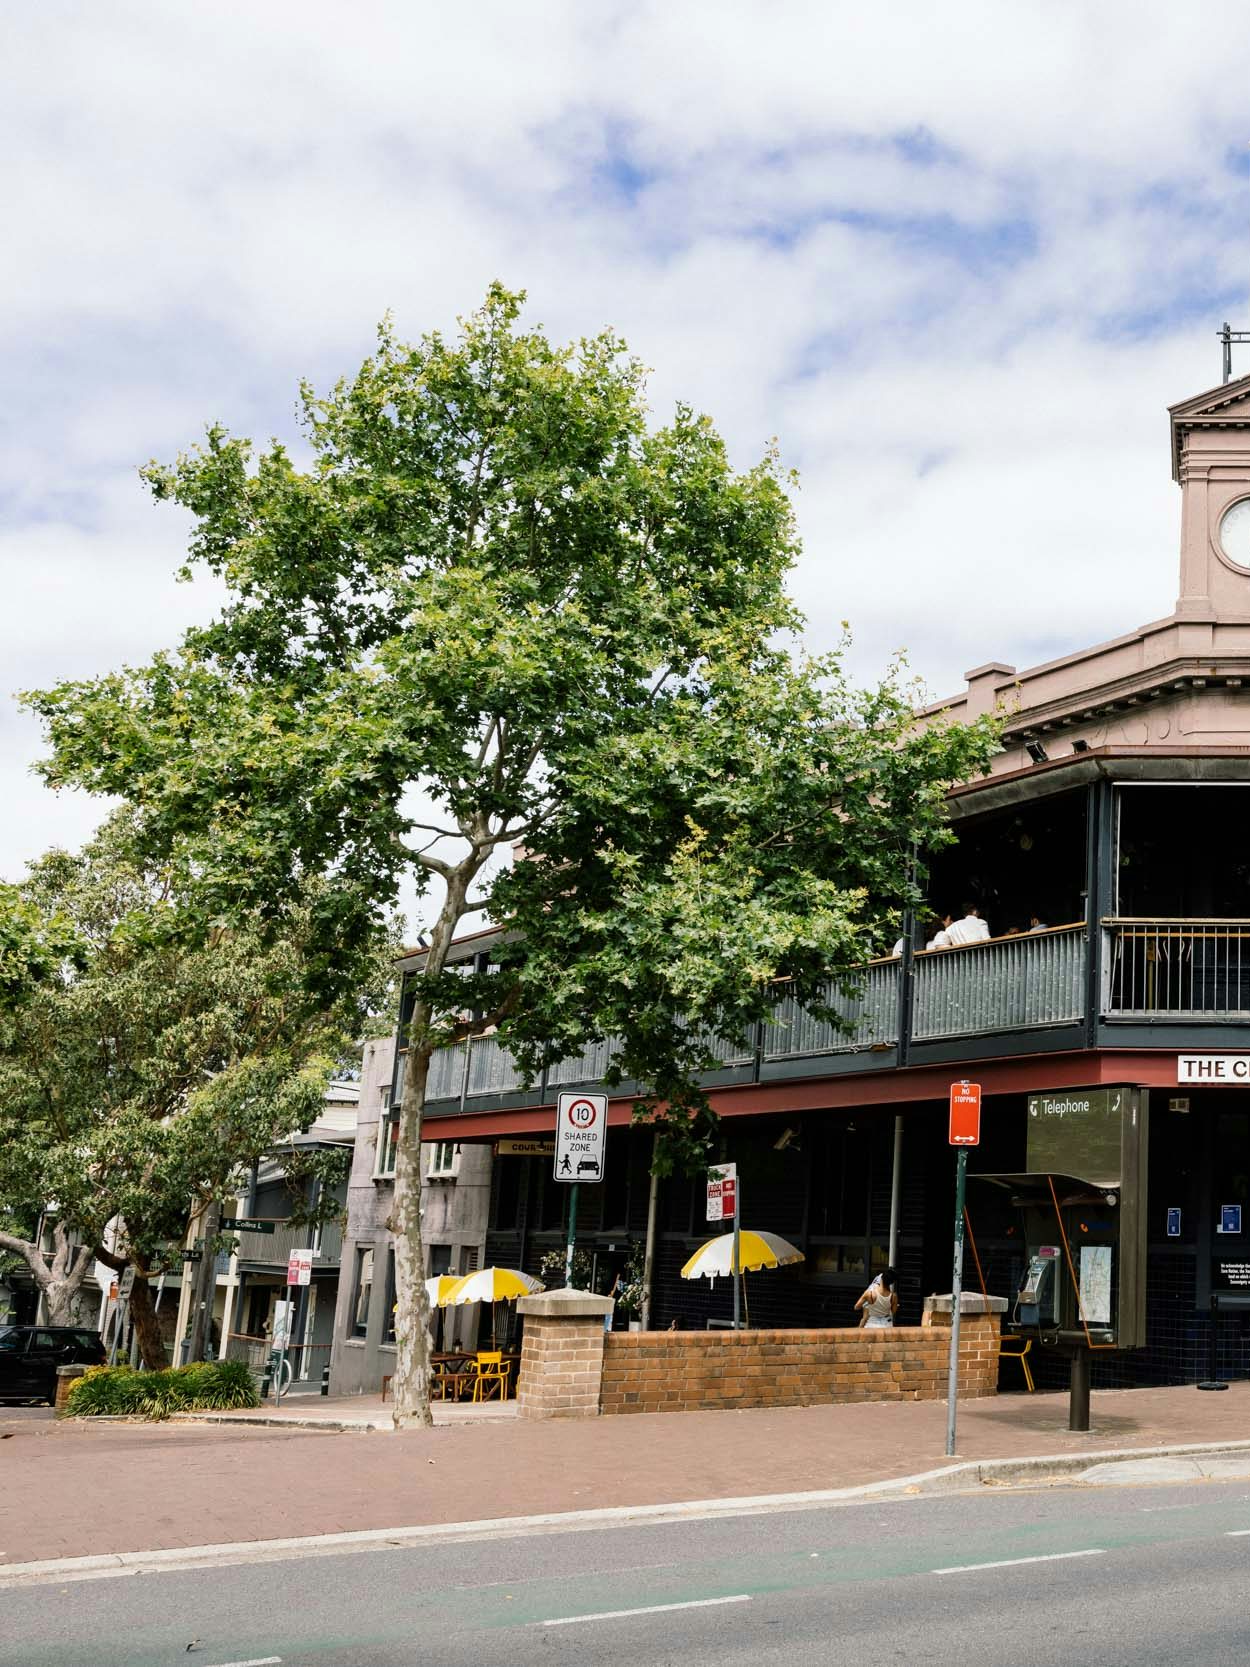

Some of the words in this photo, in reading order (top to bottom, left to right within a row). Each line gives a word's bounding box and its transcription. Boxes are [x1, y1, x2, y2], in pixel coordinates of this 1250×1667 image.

[1183, 1060, 1226, 1078] THE
[1042, 1097, 1090, 1118] Telephone
[576, 1108, 590, 1121] 10
[564, 1132, 598, 1141] SHARED
[569, 1143, 591, 1152] ZONE
[709, 1190, 721, 1198] ZONE
[235, 1220, 257, 1229] Collins
